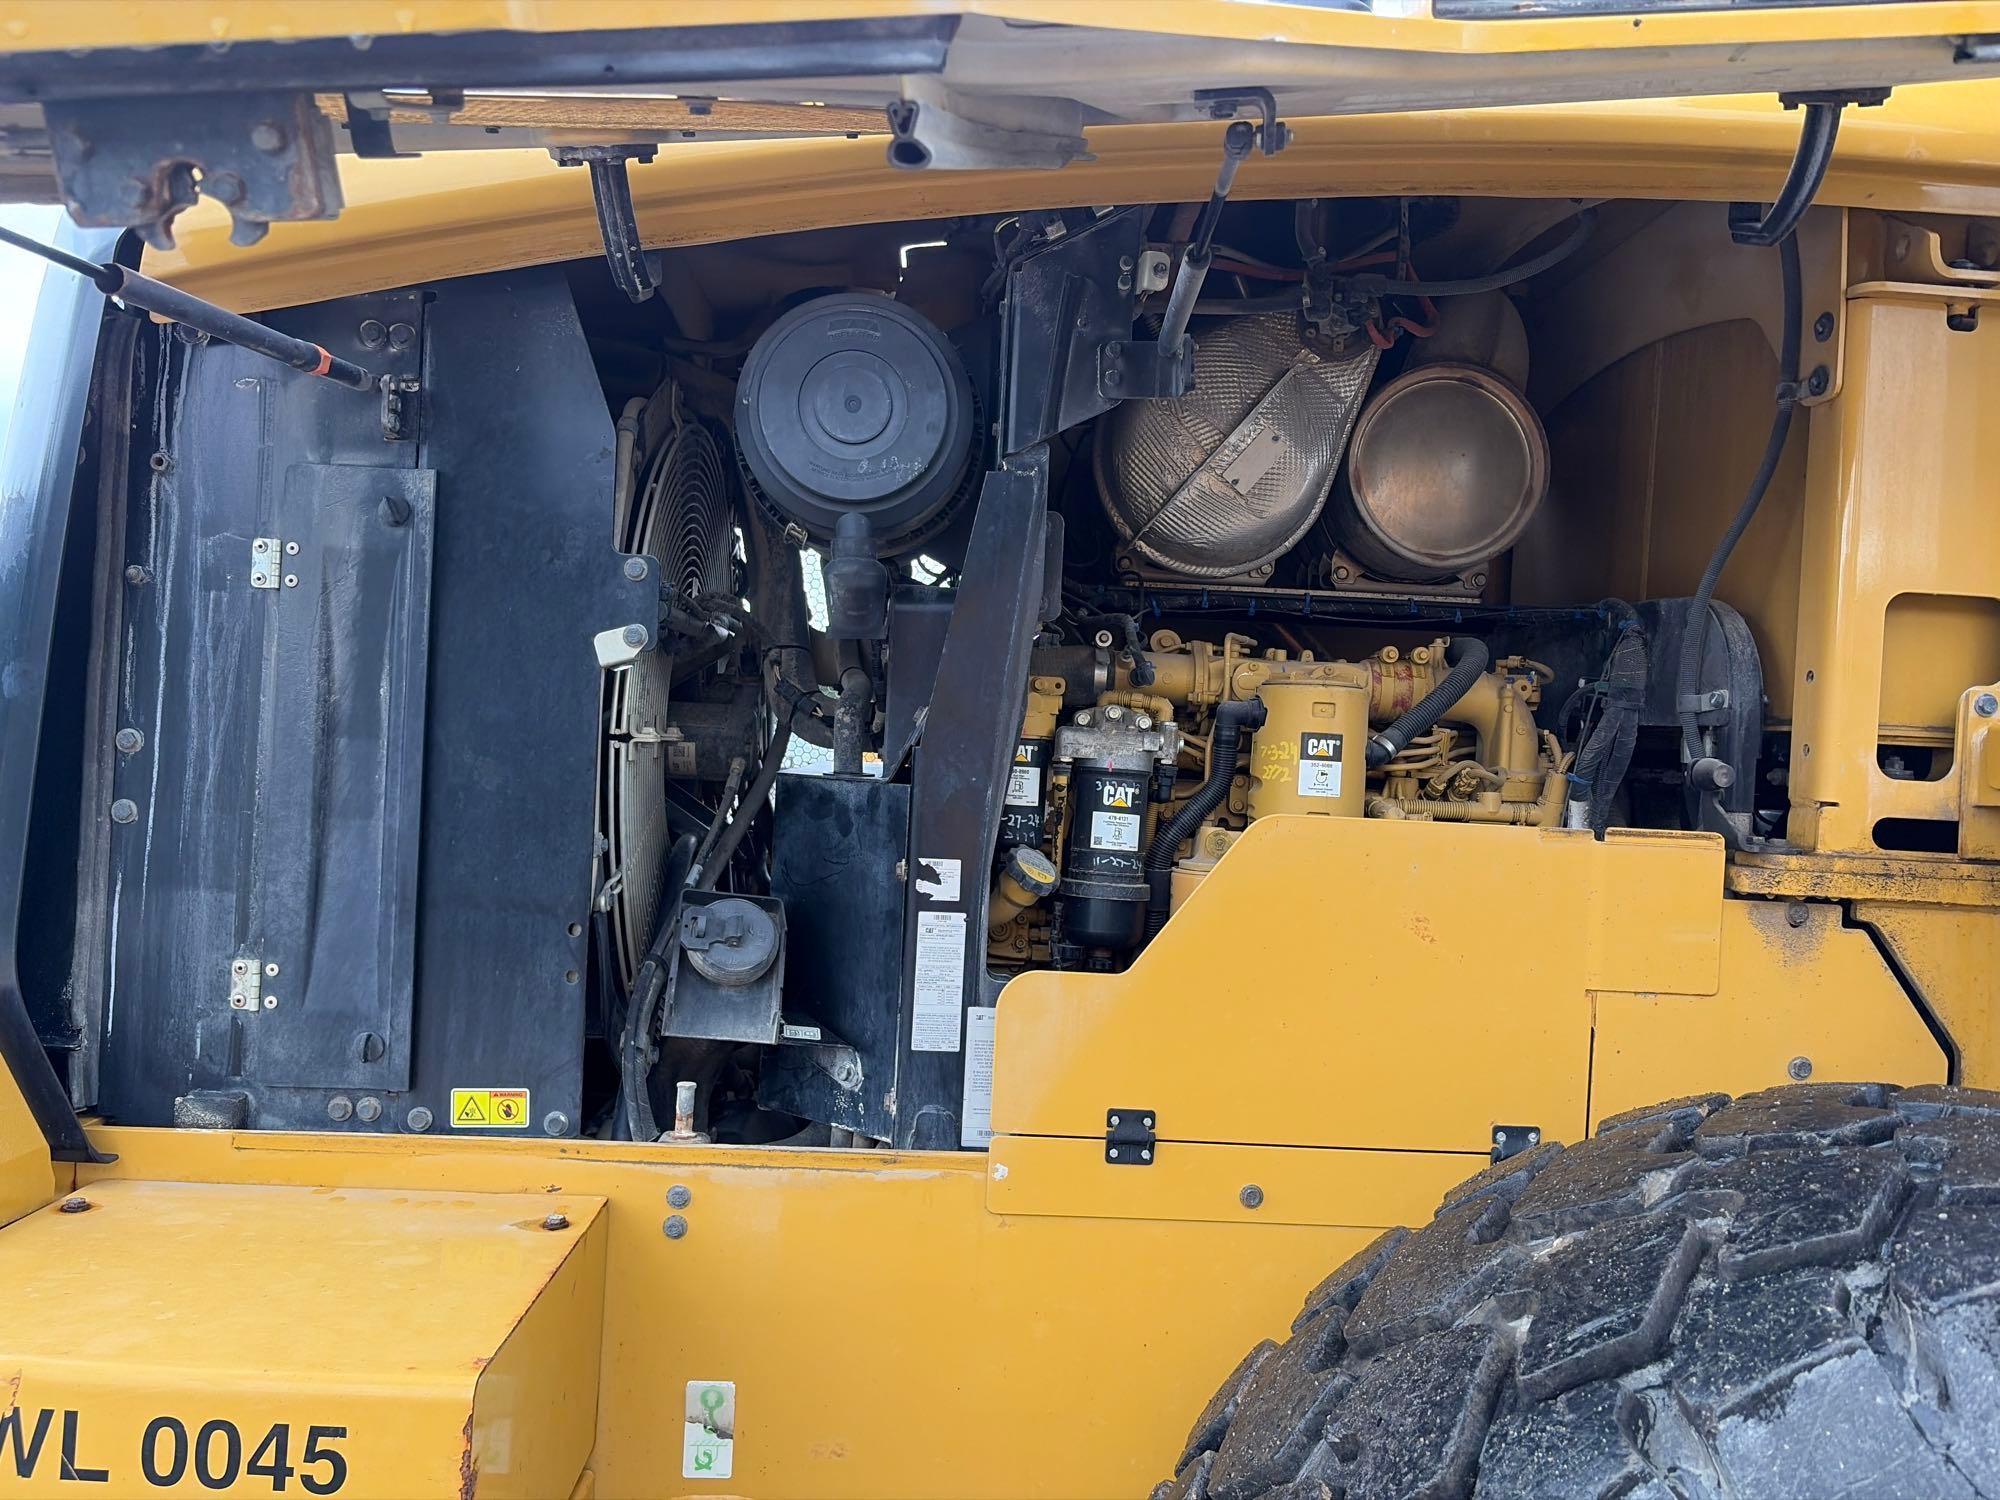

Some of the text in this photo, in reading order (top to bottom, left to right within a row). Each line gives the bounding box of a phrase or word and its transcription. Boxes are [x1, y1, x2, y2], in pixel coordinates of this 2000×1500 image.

[1014, 744, 1034, 762] AT
[1307, 738, 1336, 757] CAT
[1102, 784, 1135, 808] CAT
[140, 1415, 349, 1497] 0045
